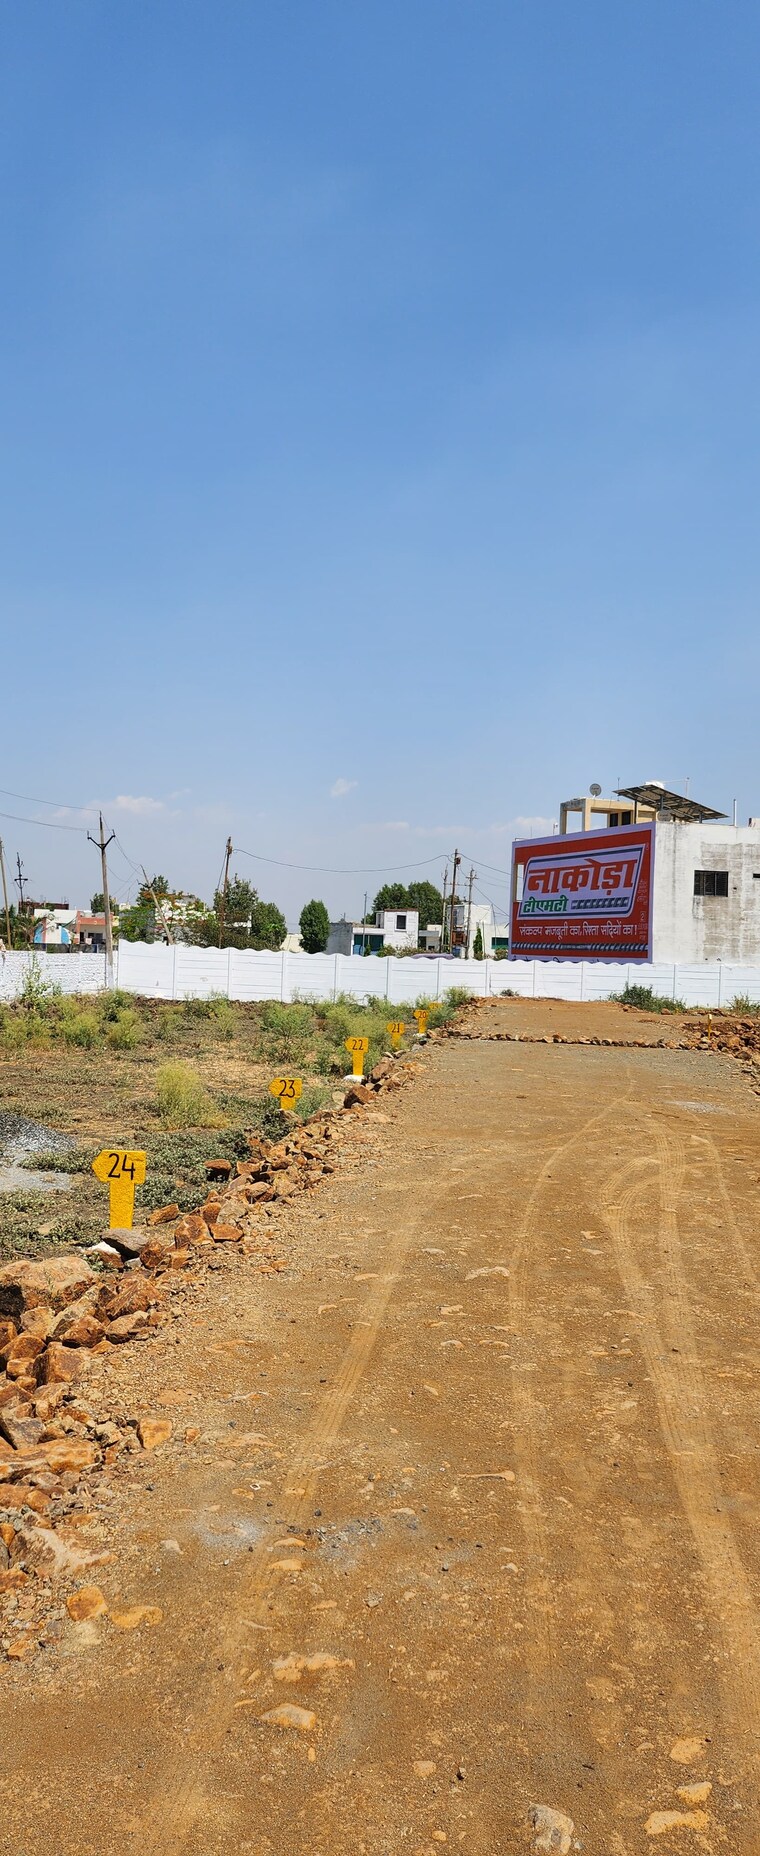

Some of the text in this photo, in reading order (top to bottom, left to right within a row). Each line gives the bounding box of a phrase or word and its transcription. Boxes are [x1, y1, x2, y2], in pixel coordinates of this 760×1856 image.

[528, 859, 638, 895] नाकोड़ा
[523, 895, 569, 913] टीएमटी
[519, 924, 544, 936] संकल्प
[391, 1023, 400, 1033] 21
[352, 1039, 364, 1051] 22
[279, 1079, 296, 1098] 23
[107, 1153, 136, 1181] 24
